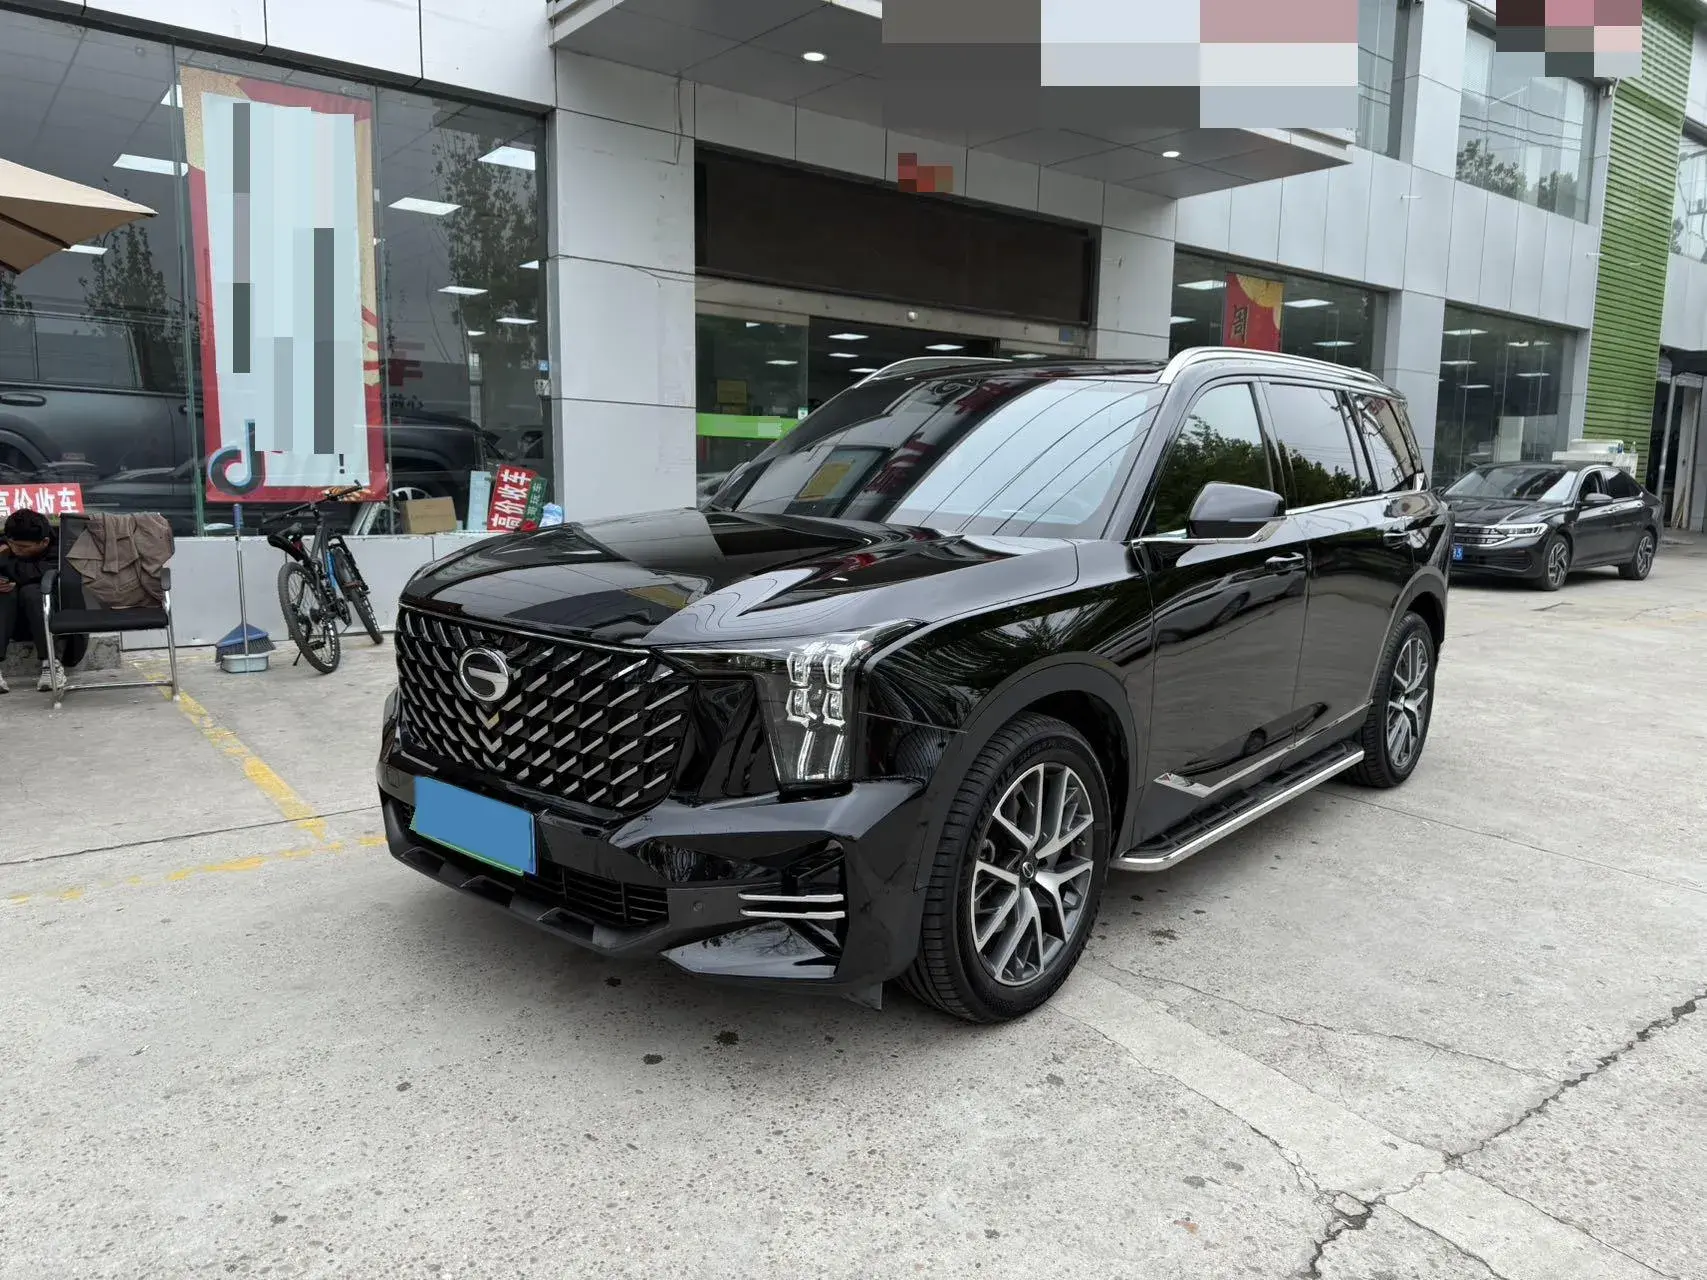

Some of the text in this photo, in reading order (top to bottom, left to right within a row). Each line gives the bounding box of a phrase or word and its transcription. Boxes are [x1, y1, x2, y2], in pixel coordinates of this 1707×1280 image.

[491, 469, 531, 528] 高价收车
[525, 482, 542, 520] 哥玩车
